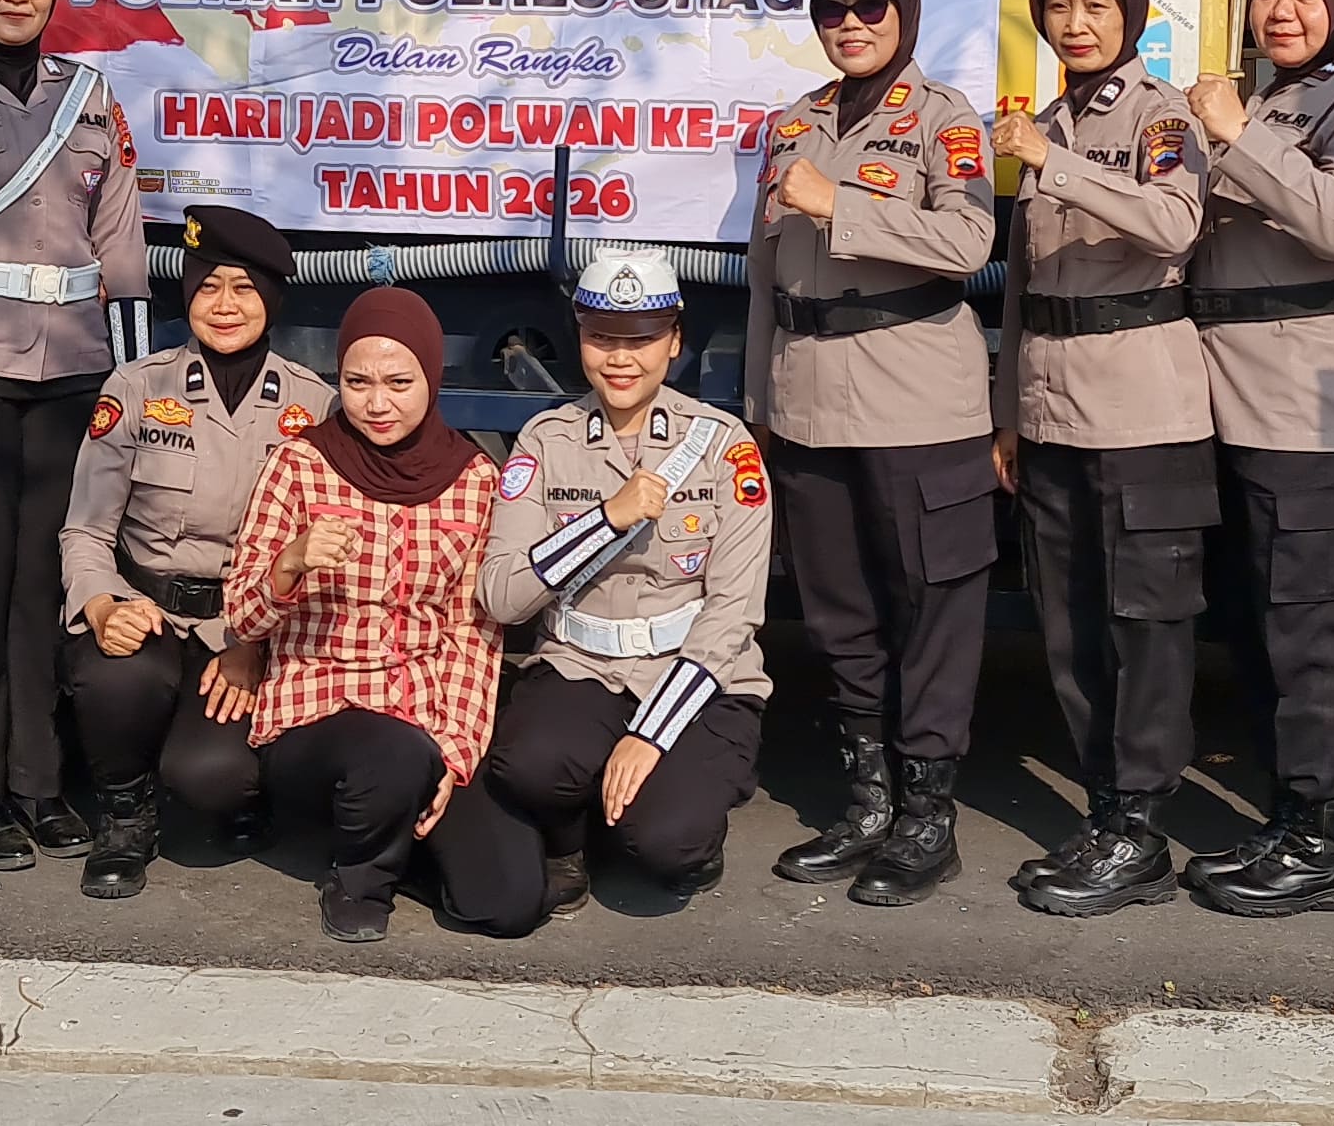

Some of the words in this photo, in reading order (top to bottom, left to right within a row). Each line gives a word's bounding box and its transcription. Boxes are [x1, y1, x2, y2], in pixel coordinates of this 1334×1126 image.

[335, 36, 461, 69] Dalam
[477, 38, 618, 83] Rangka
[77, 113, 107, 129] OLRI
[163, 96, 282, 139] HARI
[295, 99, 403, 148] JADI
[417, 101, 636, 147] POLWAN
[863, 139, 920, 159] POLRI
[1086, 148, 1132, 168] POLRI
[321, 168, 488, 213] TAHUN
[503, 175, 631, 217] 2026
[138, 426, 196, 452] NOVITA
[671, 487, 714, 503] OLRI
